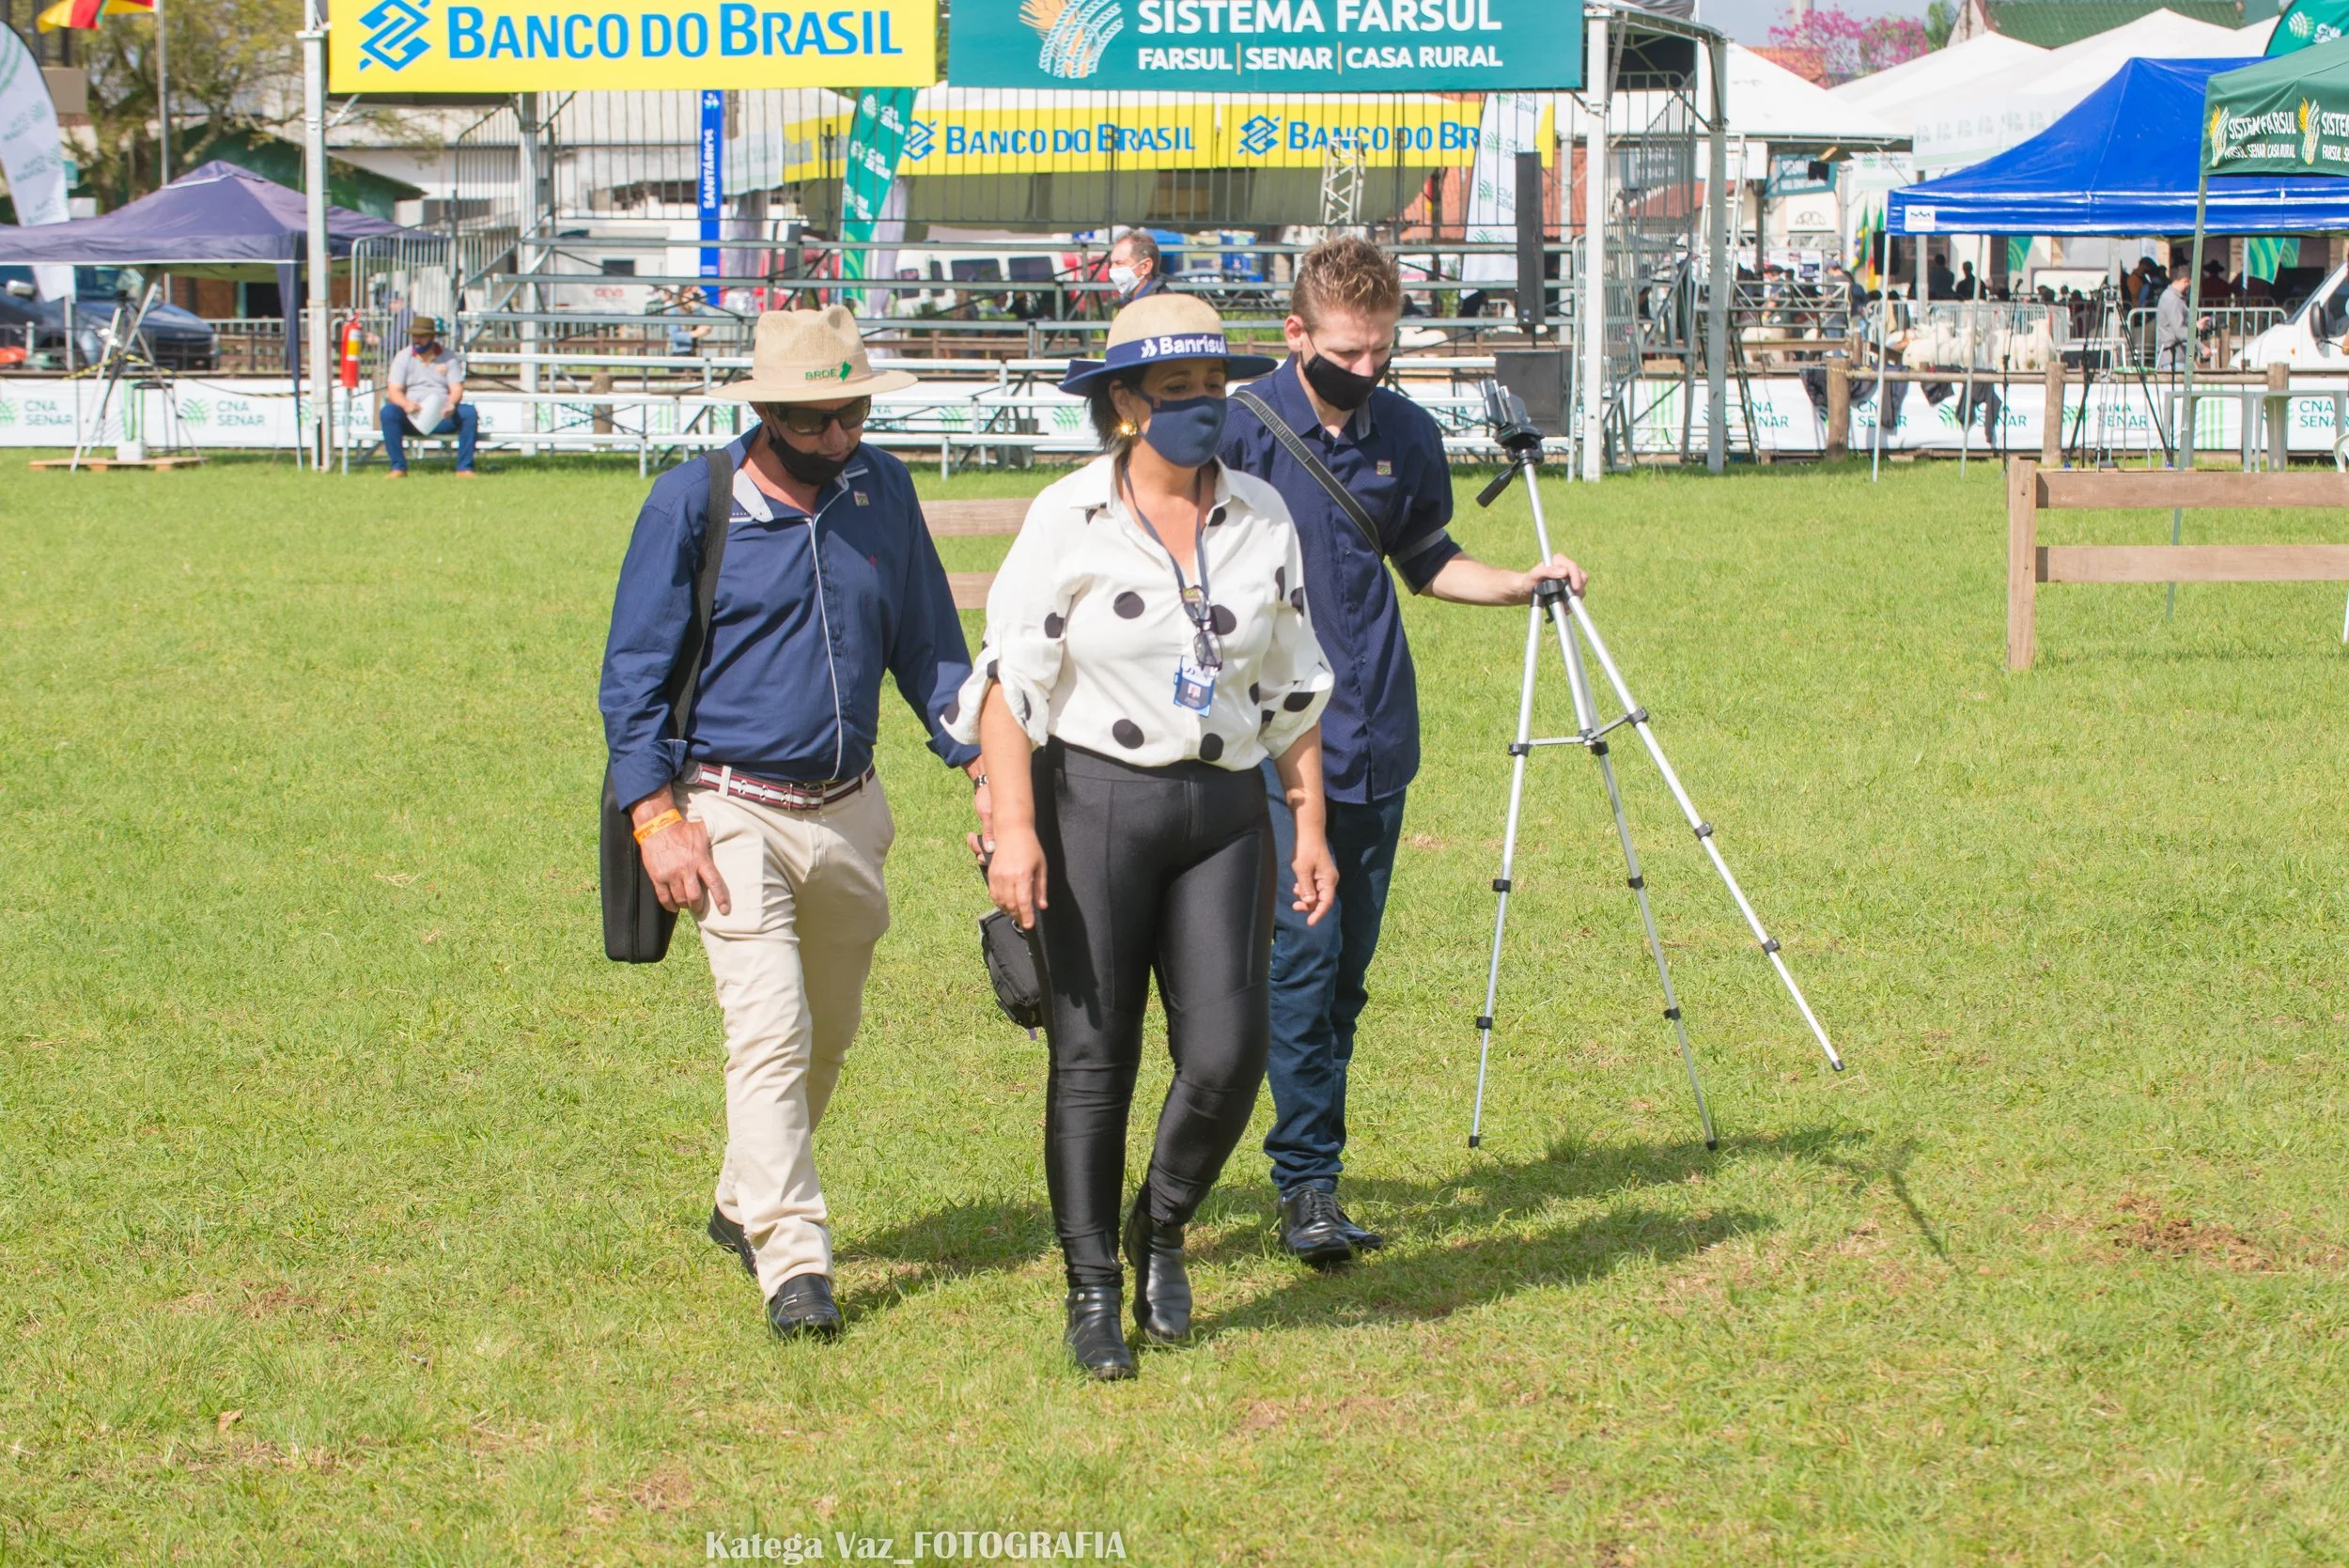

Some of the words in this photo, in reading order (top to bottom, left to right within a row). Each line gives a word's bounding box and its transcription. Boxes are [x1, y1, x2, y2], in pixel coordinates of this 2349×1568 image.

[1138, 0, 1326, 34] SISTEMA
[1336, 0, 1502, 32] FARSUL
[447, 6, 630, 59] BANCO
[641, 12, 708, 57] DO
[720, 3, 903, 56] BRASIL
[1138, 47, 1233, 70] FARSUL
[1244, 47, 1333, 70] SENAR
[1346, 46, 1414, 69] CASA
[1419, 45, 1503, 68] RURAL
[2261, 111, 2296, 135] FARSUL
[946, 126, 1047, 154] BANCO
[1053, 129, 1091, 153] DO
[1097, 123, 1196, 152] BRASIL
[1159, 334, 1226, 355] Banrisul
[804, 368, 837, 380] BRDE
[24, 400, 57, 411] CNA
[216, 400, 249, 411] CNA
[2299, 400, 2334, 412] CNA
[25, 414, 73, 426] SENAR
[217, 414, 266, 426] SENAR
